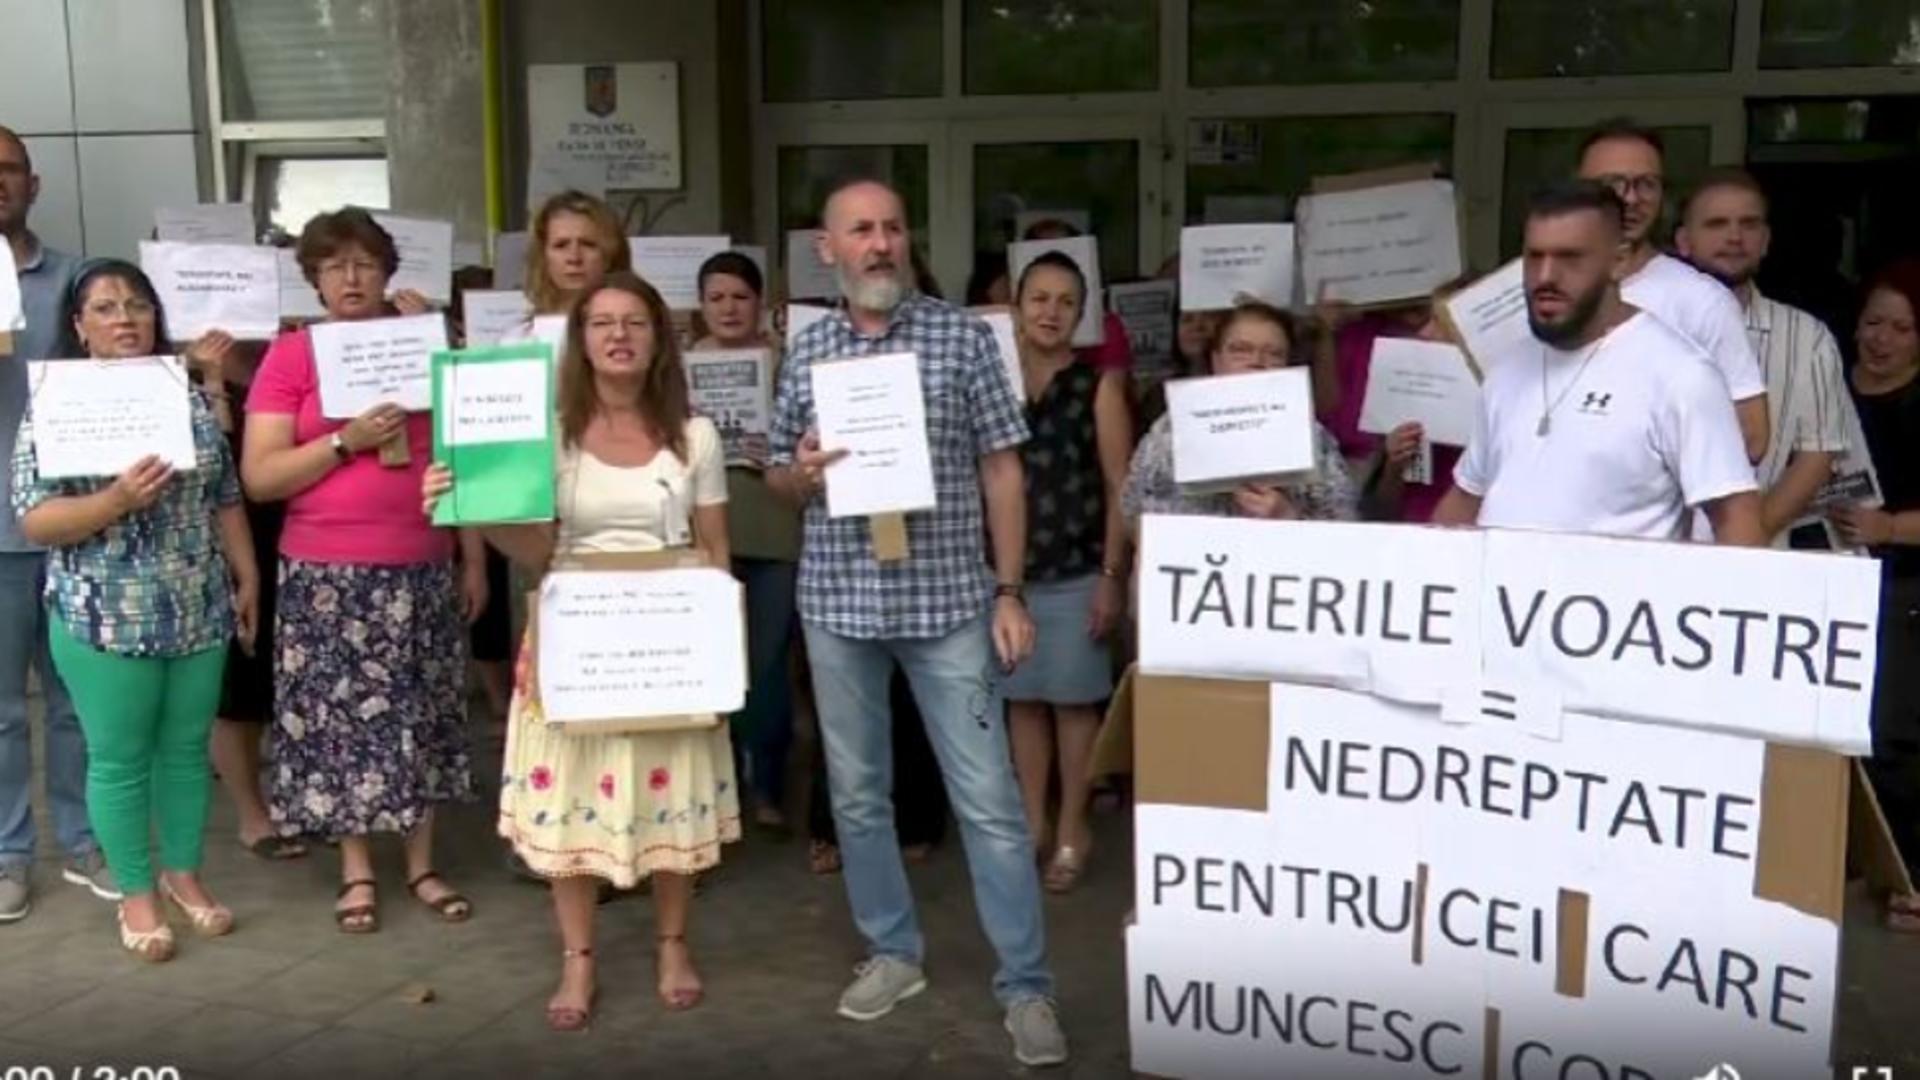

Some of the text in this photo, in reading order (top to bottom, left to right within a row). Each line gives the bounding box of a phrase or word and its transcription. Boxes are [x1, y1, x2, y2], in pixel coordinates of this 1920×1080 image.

[1159, 554, 1868, 691] TĂIERILE VOASTRE
[1482, 691, 1516, 720] =
[1285, 737, 1753, 859] NEDREPTATE
[1153, 854, 1812, 1033] PENTRU CEI CARE
[1145, 973, 1463, 1075] MUNCESC
